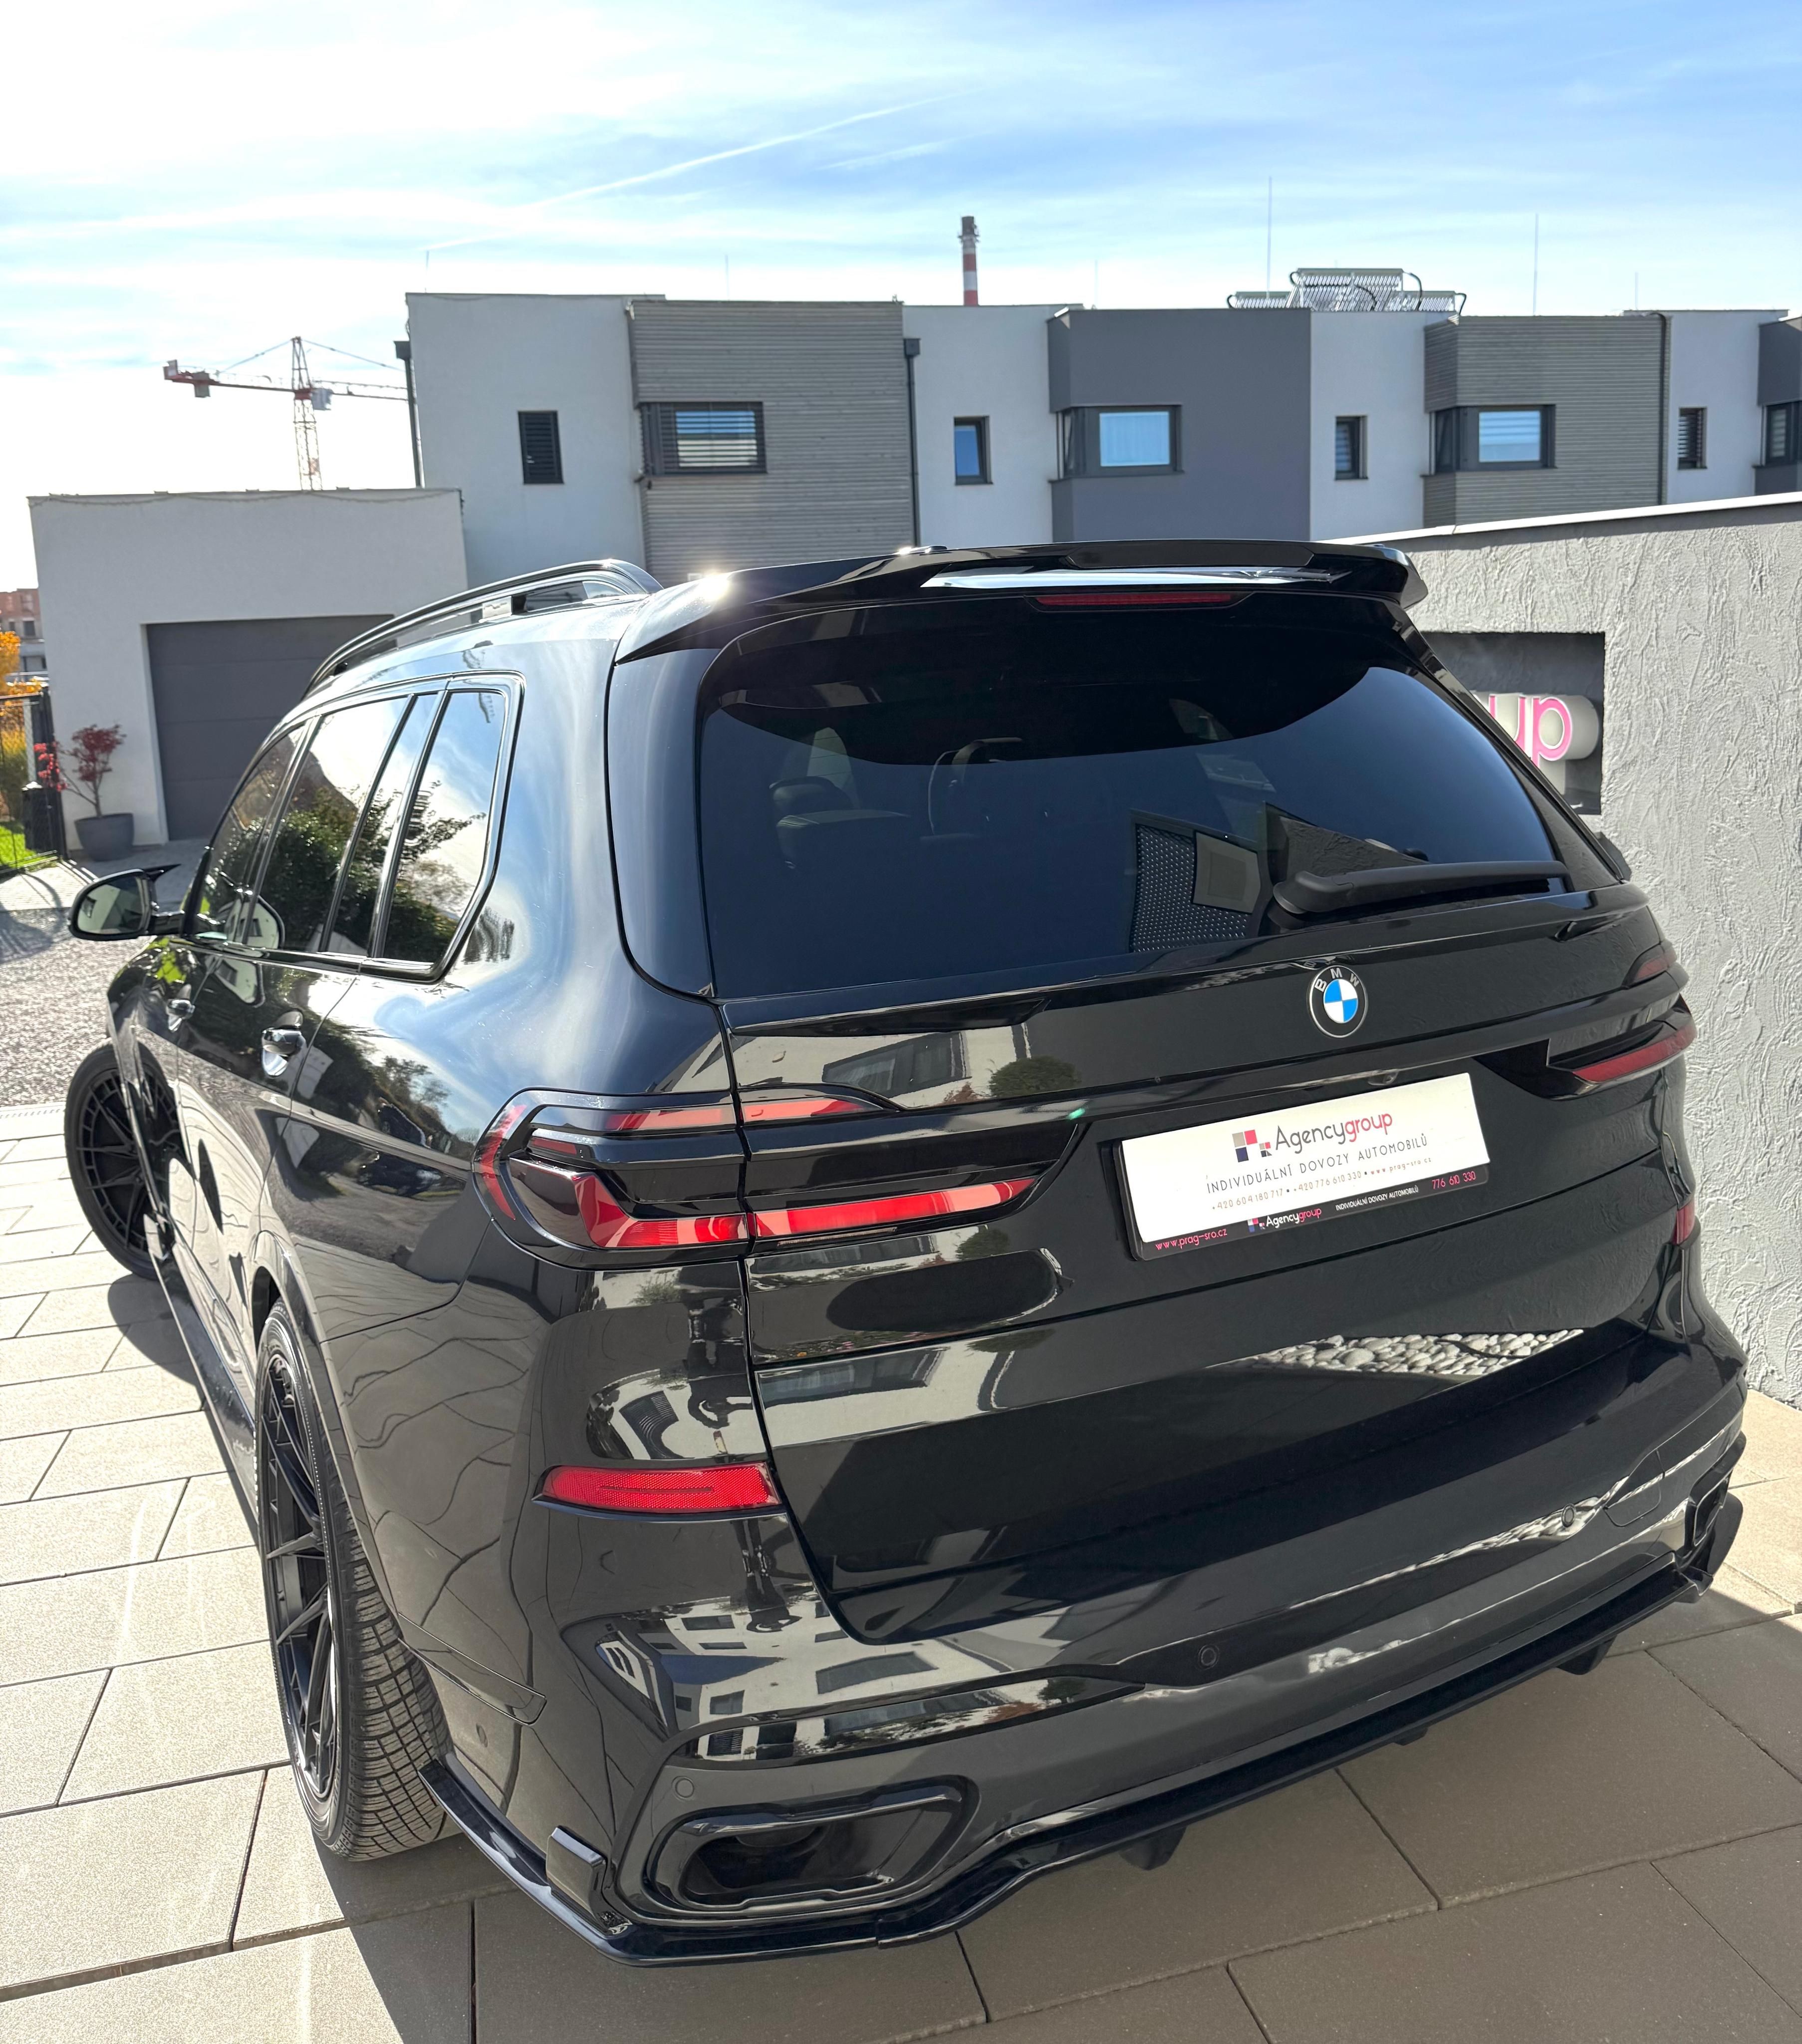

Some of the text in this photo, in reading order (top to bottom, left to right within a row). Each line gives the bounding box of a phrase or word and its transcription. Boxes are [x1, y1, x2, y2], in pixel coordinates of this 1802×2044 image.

[1314, 967, 1359, 992] BMW
[1276, 1113, 1392, 1154] Agencygroup
[1207, 1133, 1427, 1194] INDIVIDUÁLNÍ DOVOZY AUTOMOBILŮ
[1236, 1195, 1253, 1206] 604
[1255, 1192, 1269, 1202] 180
[1271, 1188, 1283, 1198] 717
[1315, 1178, 1330, 1188] 776
[1333, 1174, 1345, 1184] 610
[1347, 1171, 1361, 1181] 330
[1155, 1171, 1476, 1251] www.prag-sro.cz Agencygroup INDIVIDUÁLNÍ DOVOZY AUTOMOBILŮ 776 610 330
